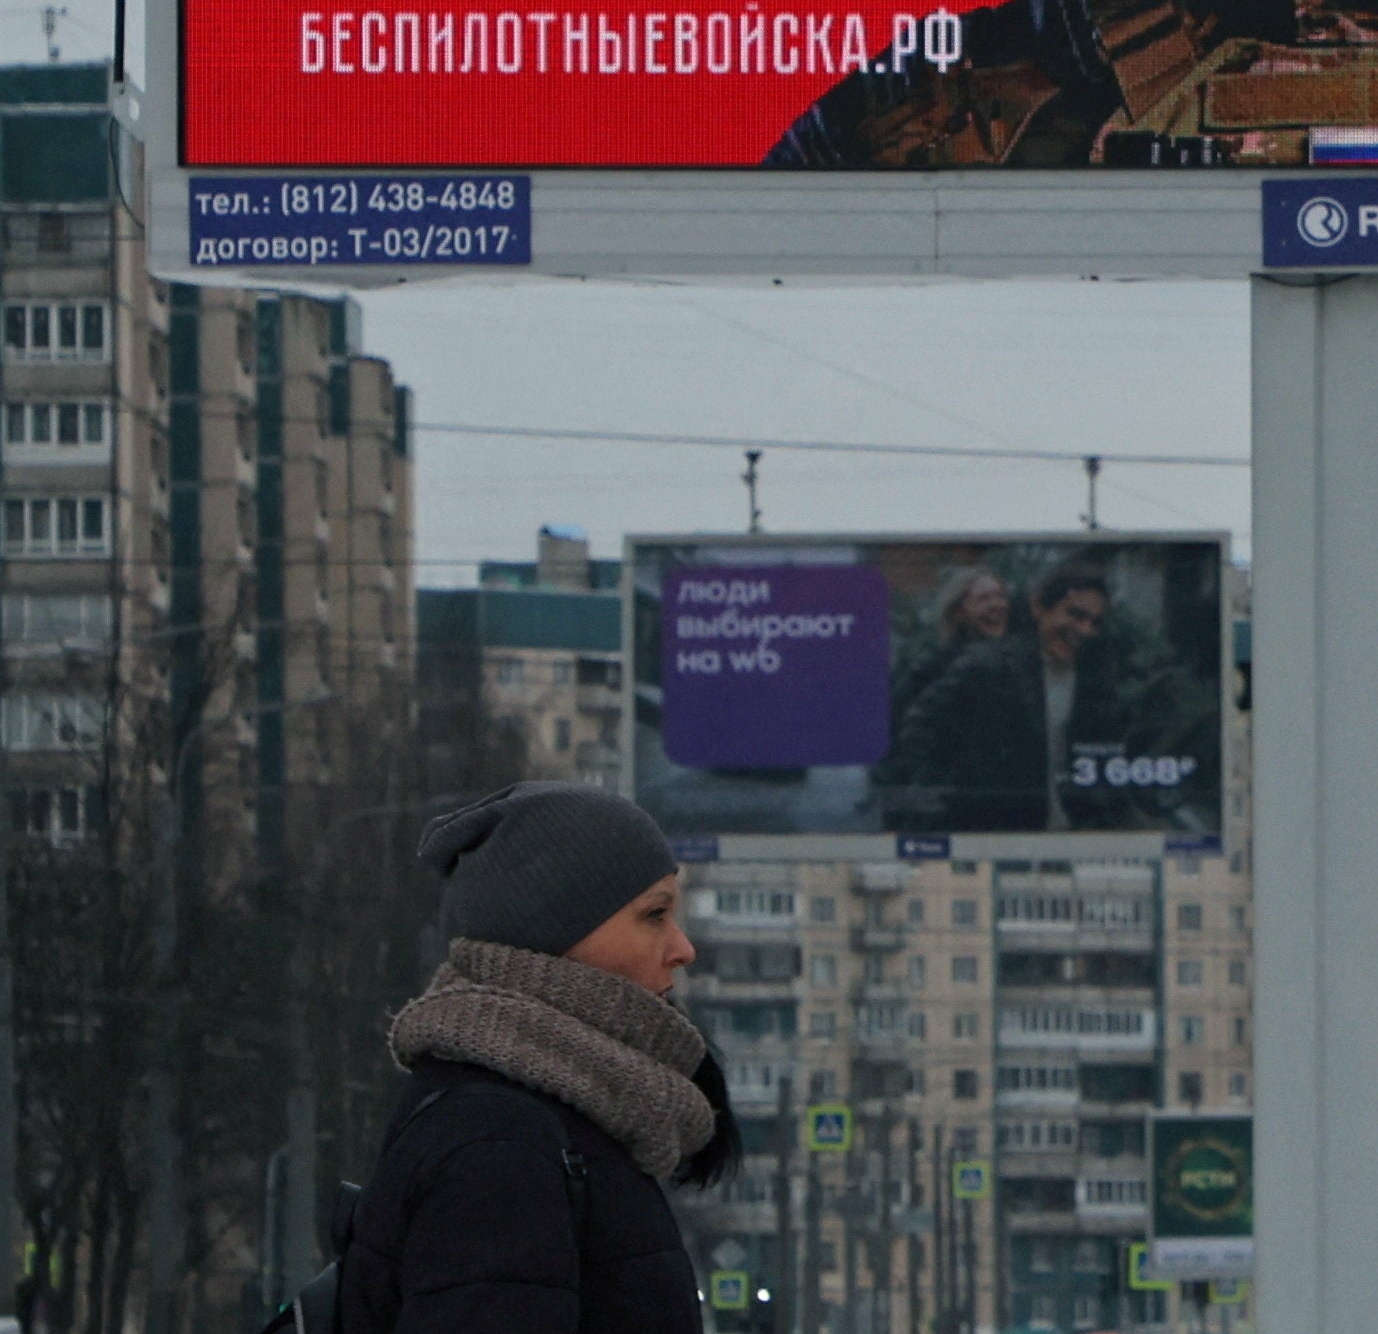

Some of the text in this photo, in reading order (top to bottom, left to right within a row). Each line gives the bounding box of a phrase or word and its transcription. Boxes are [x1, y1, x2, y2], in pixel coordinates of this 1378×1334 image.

[302, 5, 961, 73] БЕСПИЛОТНЫЕВОЙСКА.РФ
[195, 182, 514, 215] тел.: (812) 438-4848
[197, 237, 337, 264] договор:
